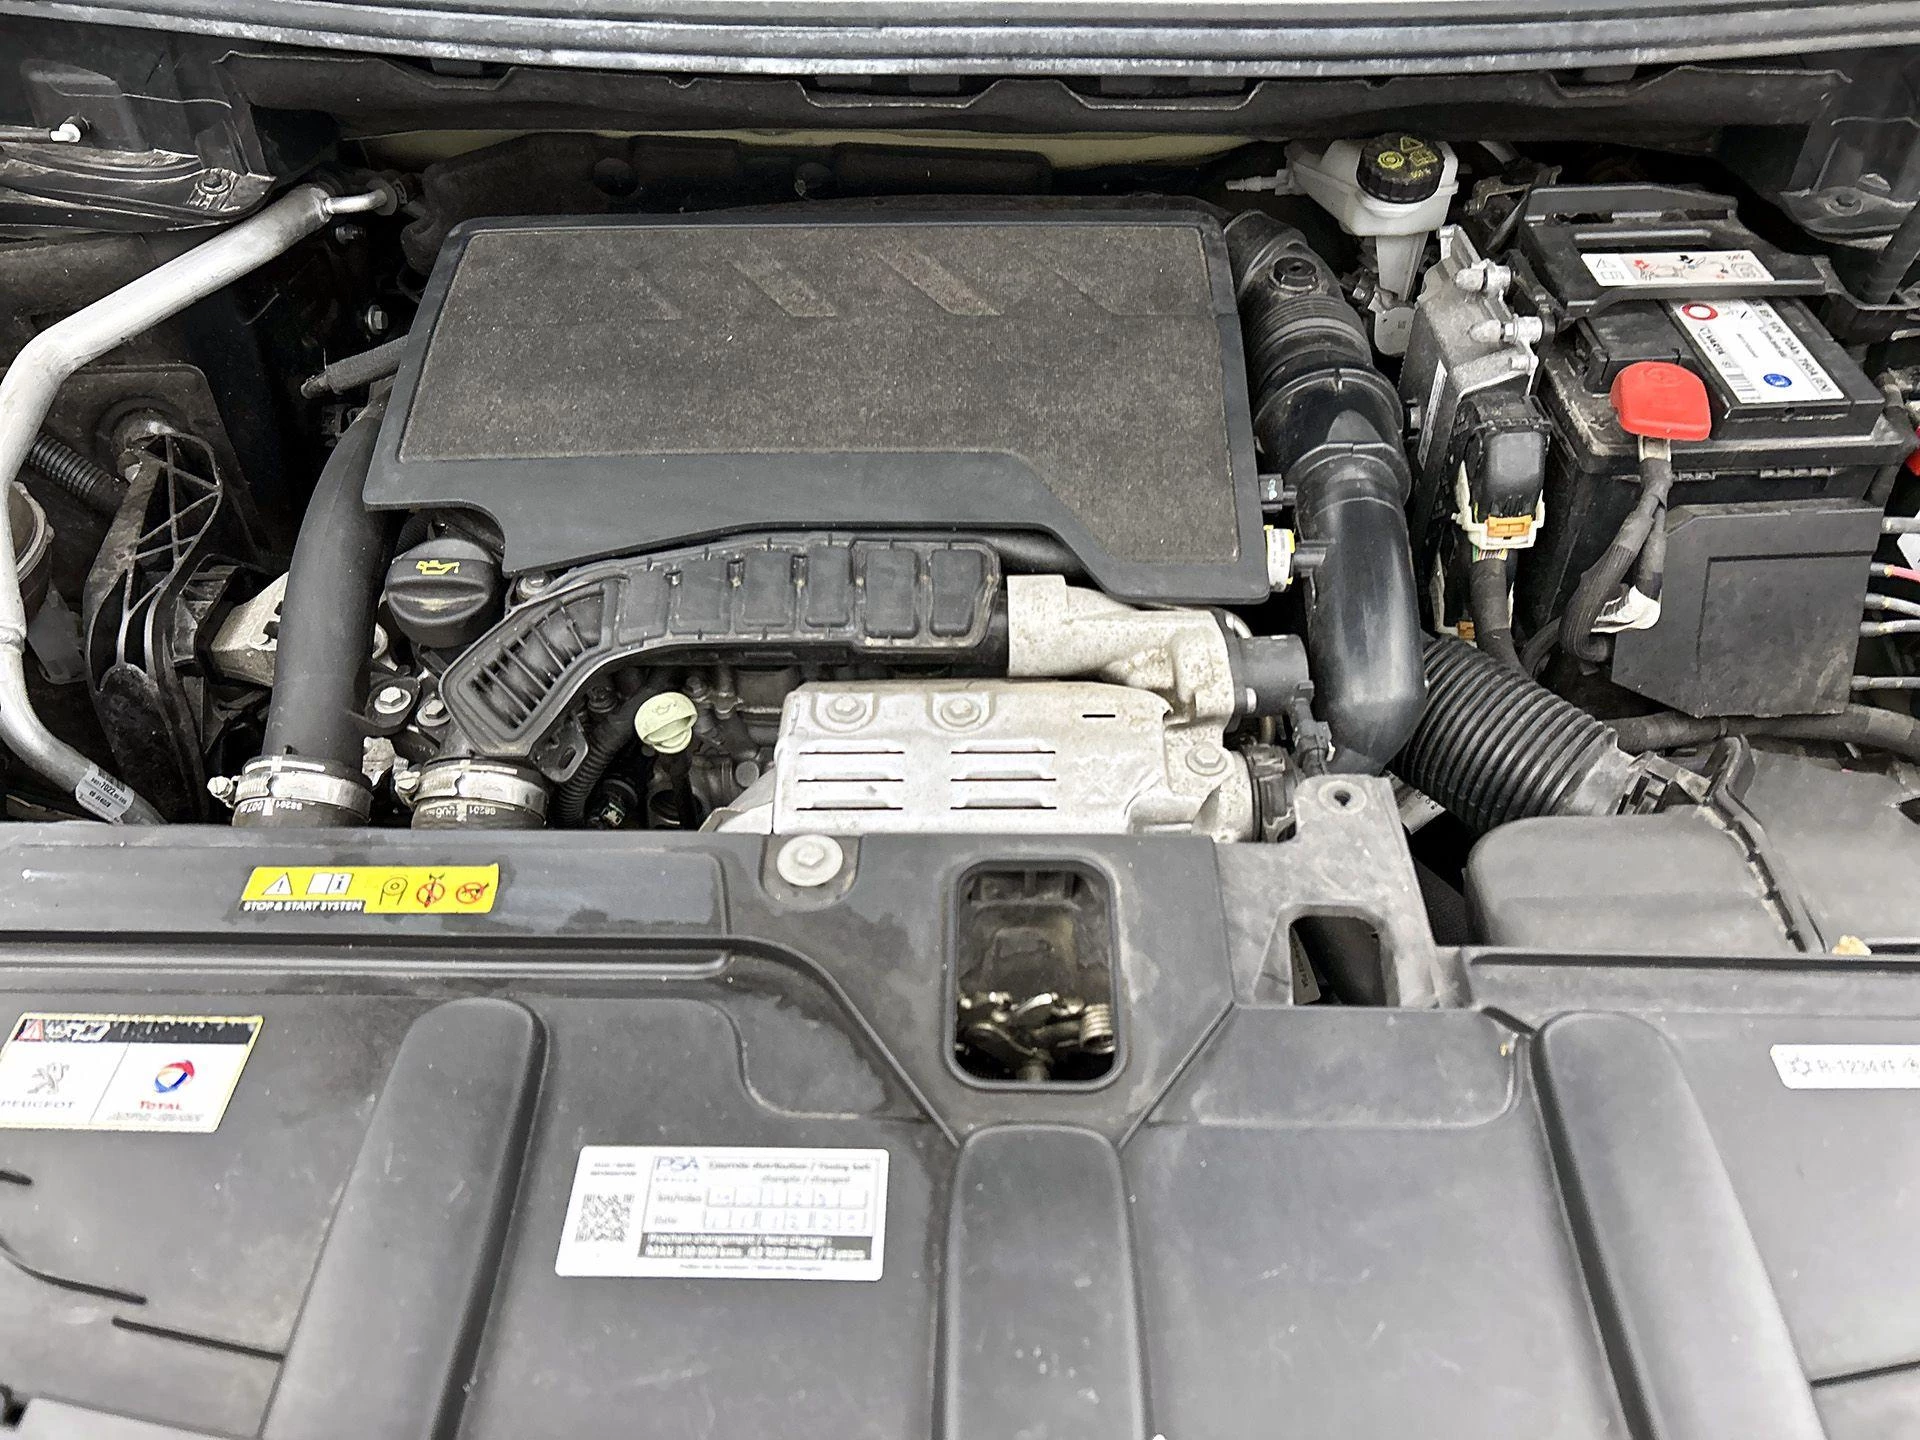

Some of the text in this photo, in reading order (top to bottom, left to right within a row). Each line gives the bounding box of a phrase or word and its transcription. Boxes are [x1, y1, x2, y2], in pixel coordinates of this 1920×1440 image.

[243, 901, 275, 912] STOP
[284, 901, 317, 912] START
[320, 901, 363, 912] SYSTEM
[139, 1099, 183, 1110] TOTAL
